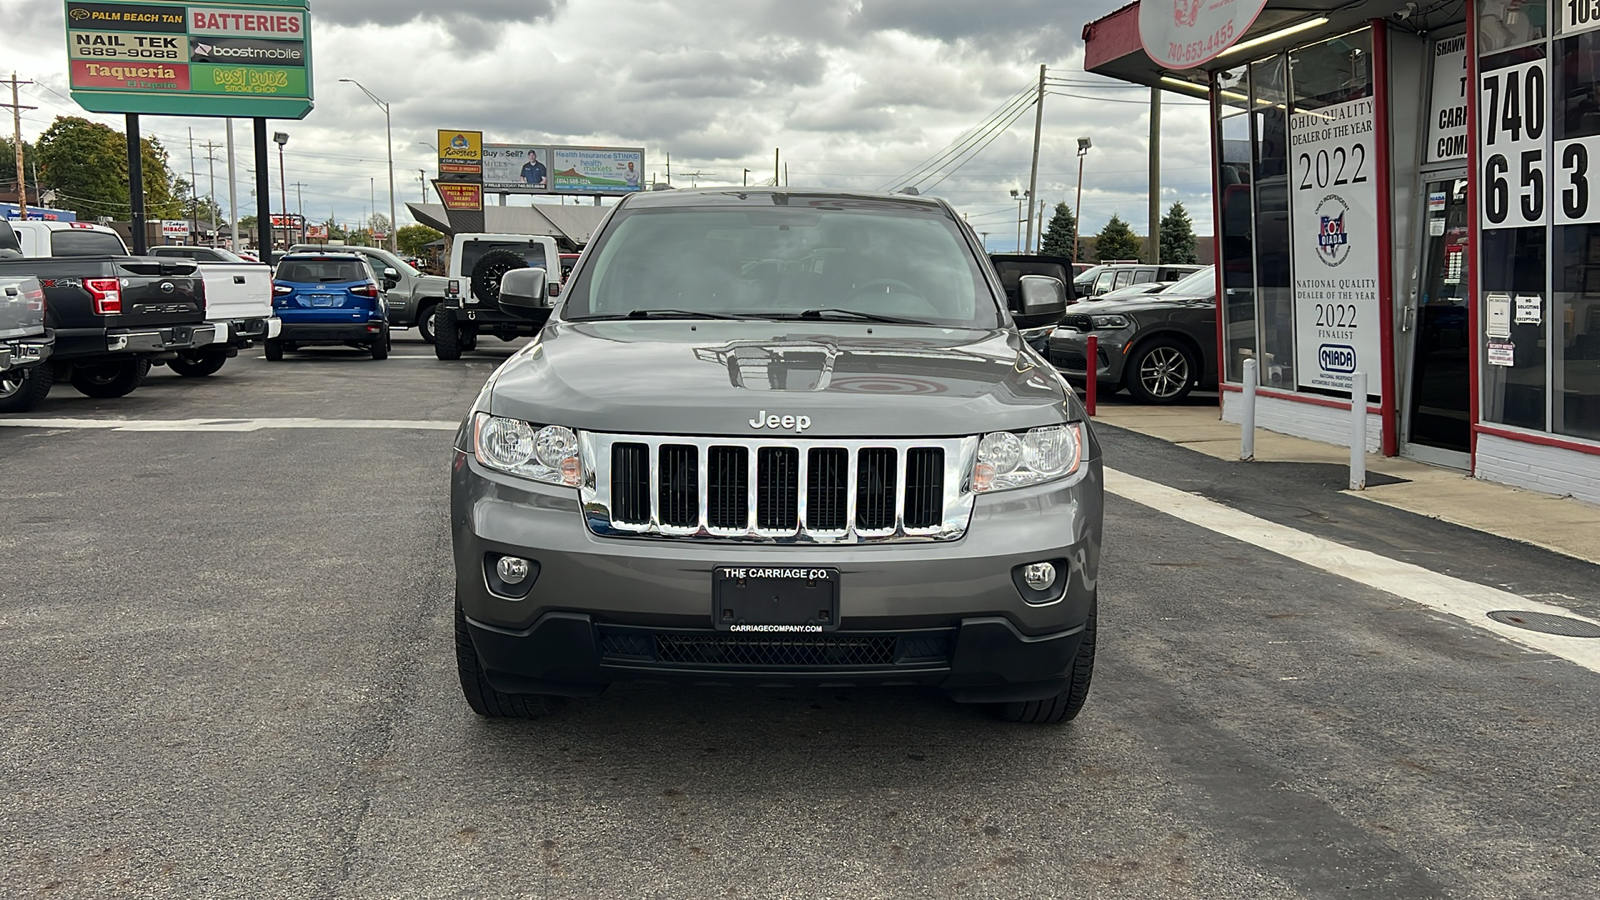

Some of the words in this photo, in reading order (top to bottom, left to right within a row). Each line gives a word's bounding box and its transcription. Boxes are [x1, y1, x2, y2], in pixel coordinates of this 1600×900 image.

[92, 11, 121, 20] PALM
[123, 13, 159, 22] BEACH
[162, 14, 182, 23] TAN
[193, 12, 300, 33] BATTERIES
[76, 34, 125, 46] NAIL
[134, 36, 178, 48] TEK
[1167, 19, 1234, 61] 740-653-4455
[80, 47, 178, 58] 689-9088
[224, 85, 253, 93] SMOKE
[254, 86, 277, 94] SHOP
[1484, 65, 1545, 146] 740
[1291, 113, 1318, 131] OHIO
[1322, 100, 1374, 126] QUALITY
[1292, 130, 1321, 146] DEALER
[1321, 127, 1332, 140] OF
[1333, 124, 1350, 138] THE
[1350, 119, 1373, 135] YEAR
[443, 146, 478, 158] Roosters
[483, 150, 498, 158] Buy
[505, 150, 524, 158] Sell?
[578, 151, 612, 160] Insurance
[612, 152, 640, 160] STINKS!
[580, 159, 602, 167] health
[583, 165, 613, 173] markets
[1298, 142, 1368, 191] 2022
[1321, 234, 1344, 245] OIADA
[1296, 279, 1336, 289] NATIONAL
[1338, 279, 1376, 290] QUALITY
[1297, 291, 1324, 300] DEALER
[1326, 291, 1336, 300] OF
[1338, 291, 1353, 300] THE
[1355, 291, 1376, 300] YEAR
[1315, 303, 1358, 329] 2022
[1318, 330, 1354, 340] FINALIST
[1321, 350, 1353, 368] NIADA
[748, 410, 811, 433] Jeep
[724, 568, 747, 578] THE
[749, 568, 808, 579] CARRIAGE
[809, 569, 829, 579] CO.
